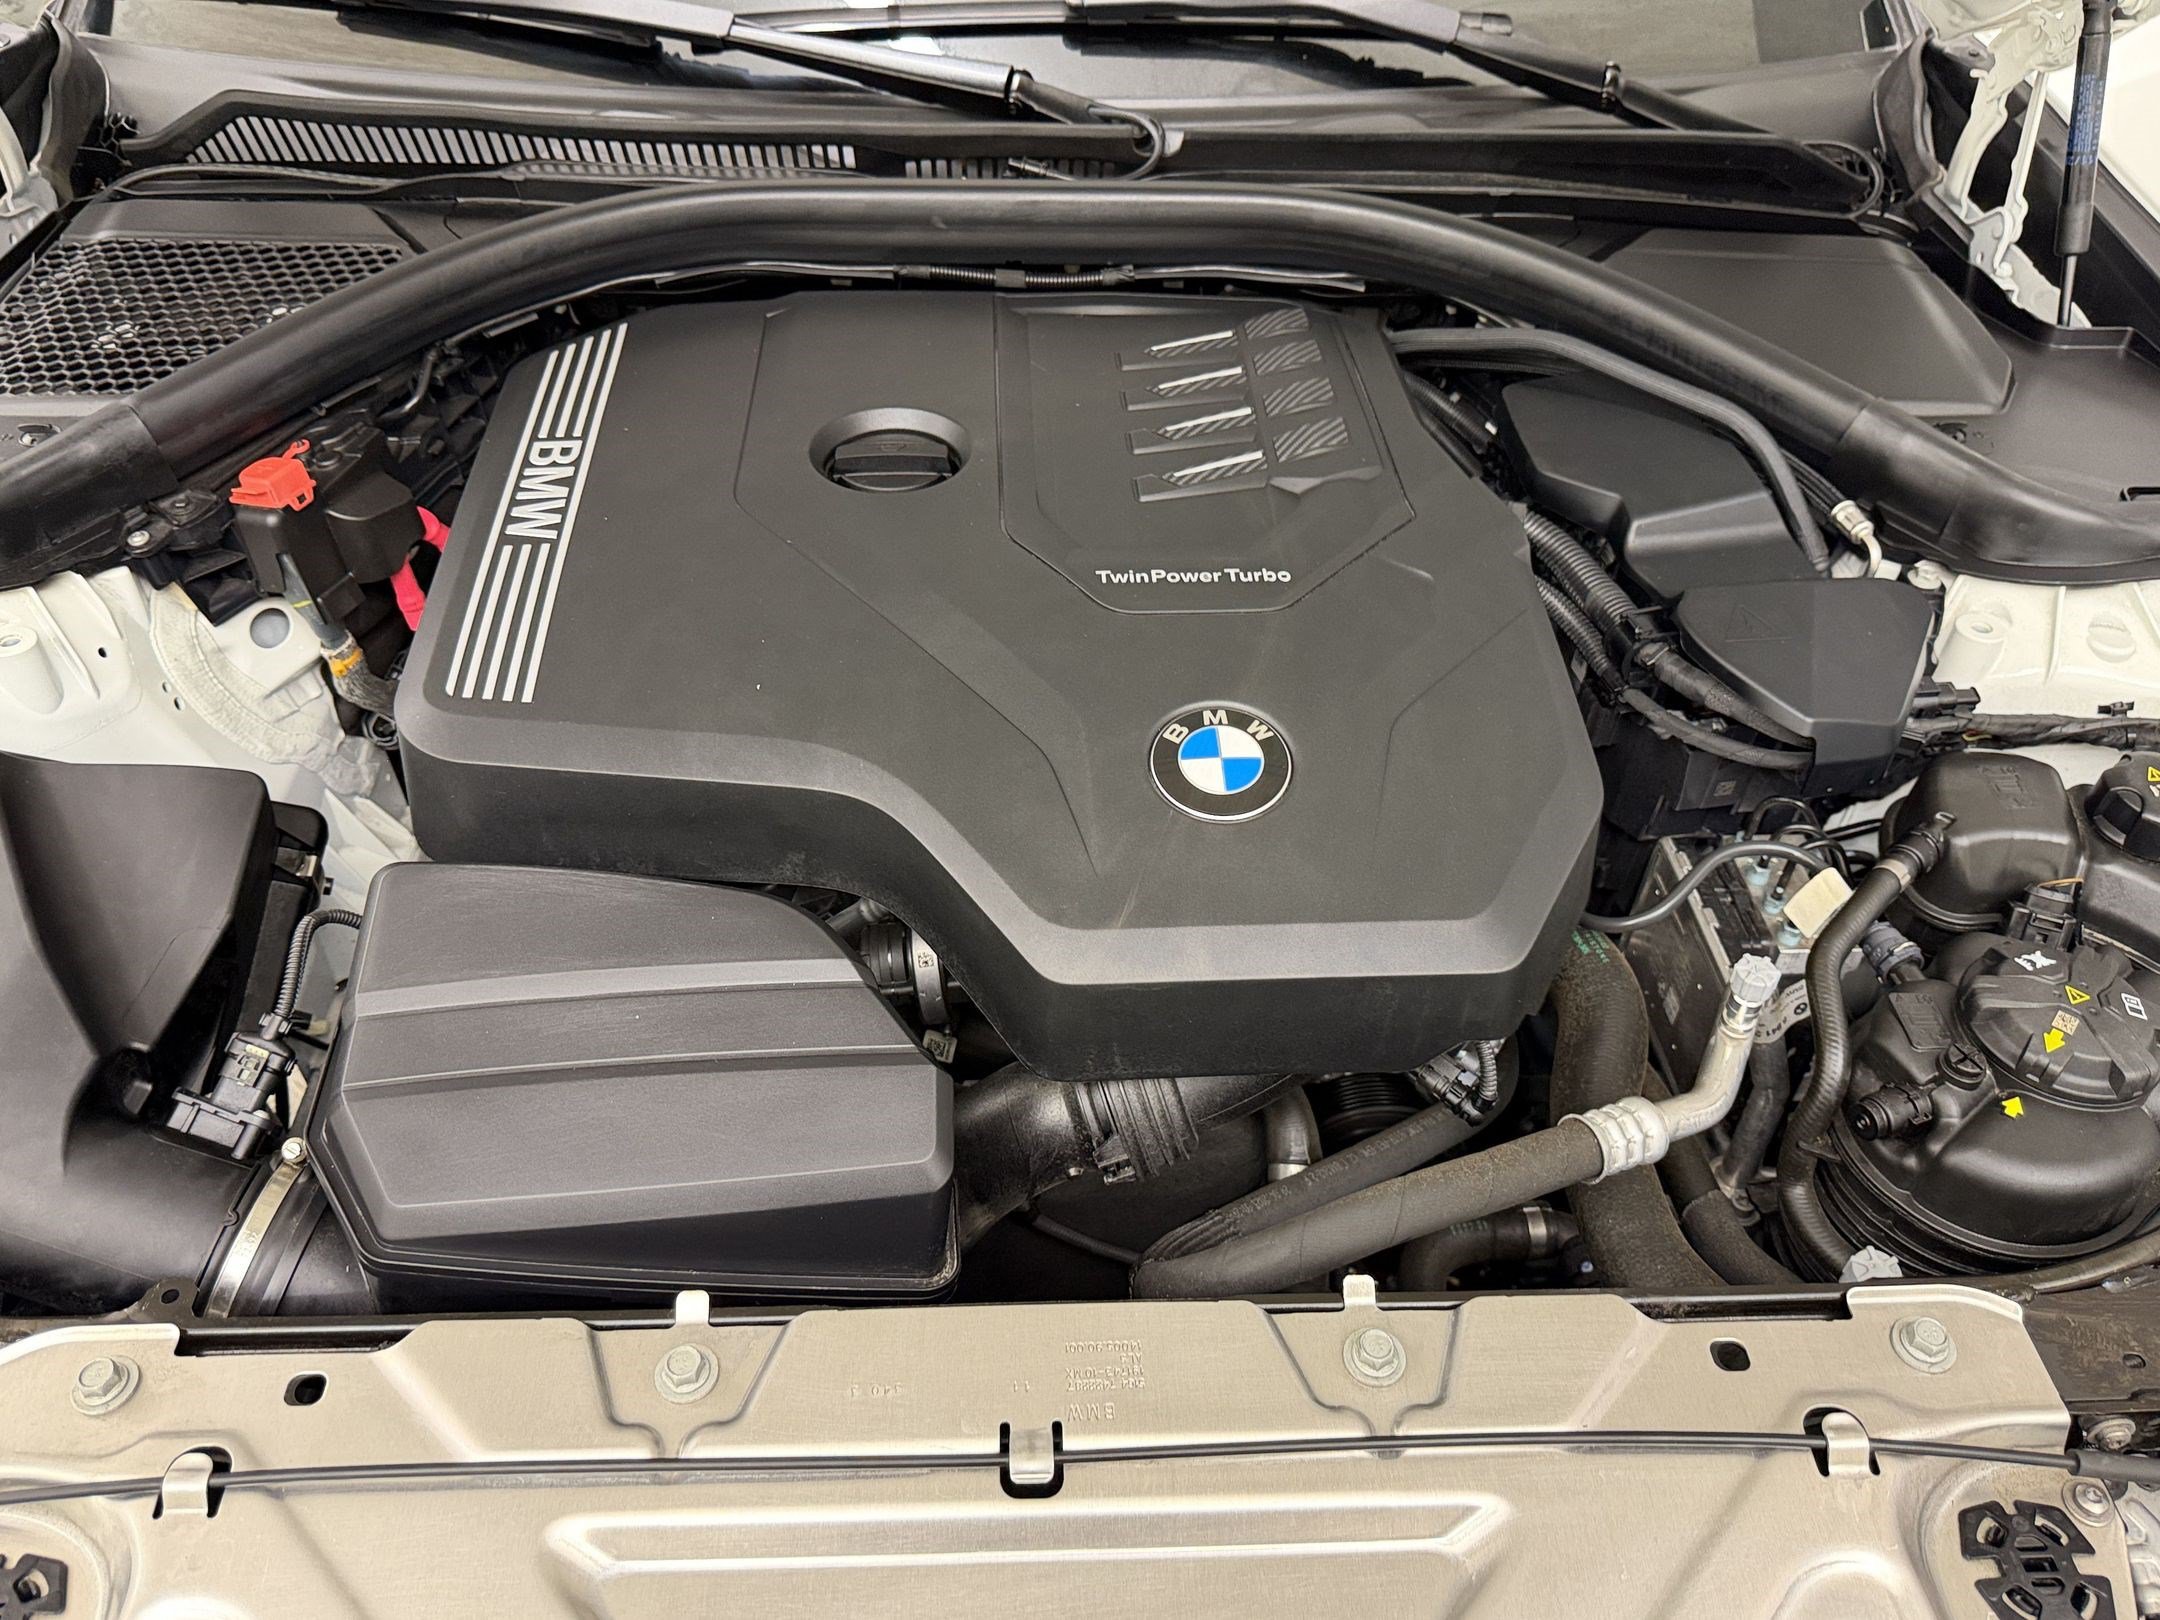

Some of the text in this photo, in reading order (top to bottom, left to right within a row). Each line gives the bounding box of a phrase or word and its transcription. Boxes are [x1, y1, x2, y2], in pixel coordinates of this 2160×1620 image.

[504, 440, 583, 539] BMW
[1223, 568, 1292, 583] Turbo
[1162, 709, 1275, 744] BMW
[1067, 1402, 1115, 1421] BMW
